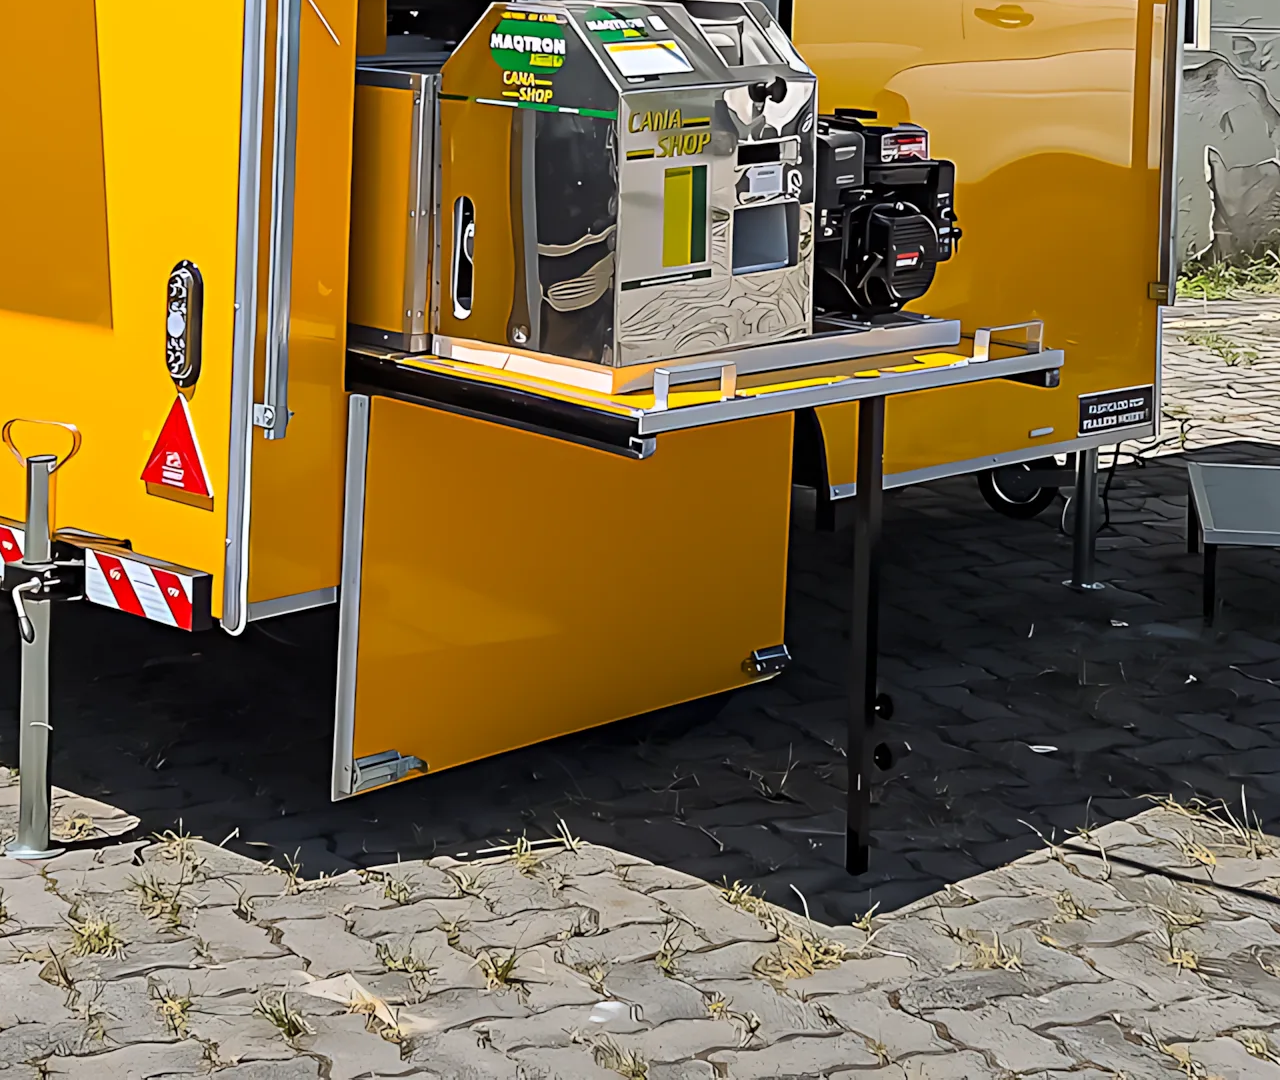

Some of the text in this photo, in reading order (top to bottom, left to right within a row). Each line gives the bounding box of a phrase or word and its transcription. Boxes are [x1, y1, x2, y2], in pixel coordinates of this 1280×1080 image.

[490, 32, 566, 55] MAQTRON
[519, 86, 553, 103] SHOP
[628, 108, 682, 134] CANA
[656, 132, 712, 158] SHOP
